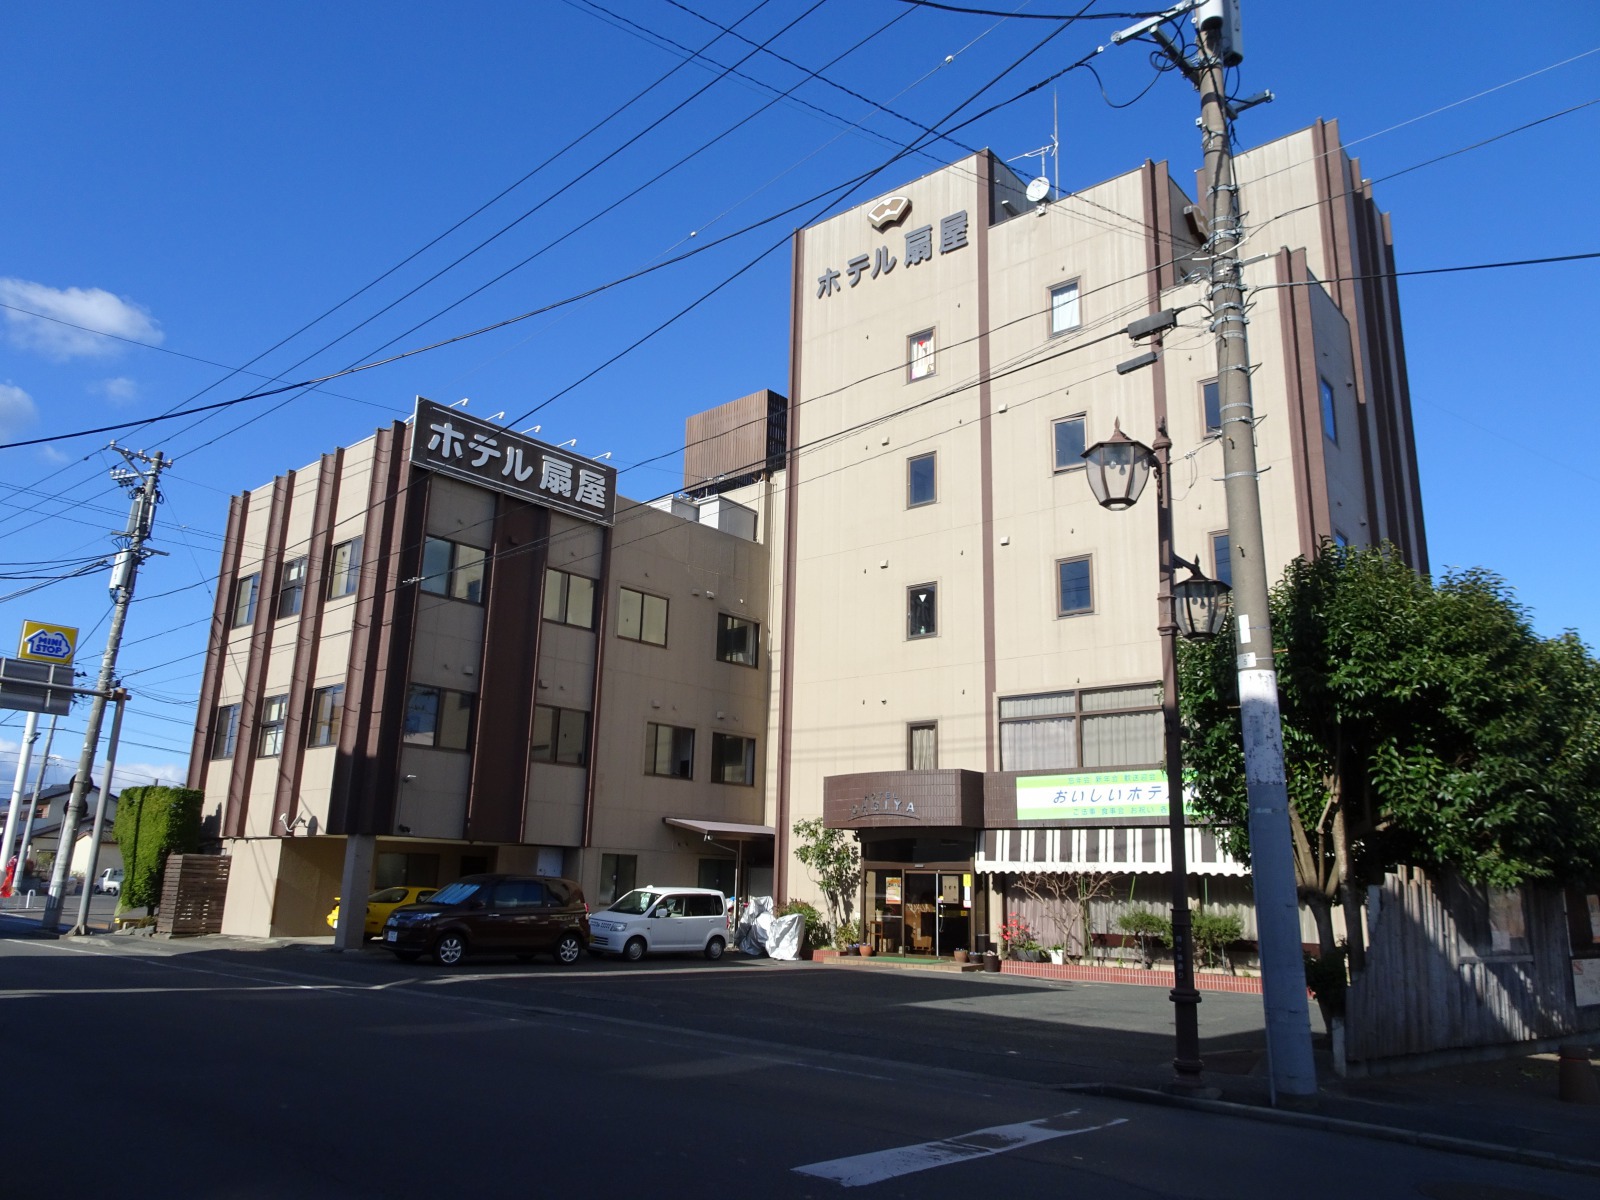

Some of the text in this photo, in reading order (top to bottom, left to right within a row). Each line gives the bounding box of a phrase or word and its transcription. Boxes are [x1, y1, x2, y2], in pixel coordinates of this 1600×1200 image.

[816, 209, 969, 299] ホテル扇屋
[427, 422, 606, 509] ホテル扇屋
[36, 644, 62, 653] STOP
[38, 637, 62, 646] MINI
[1053, 786, 1169, 804] おいしいホテ
